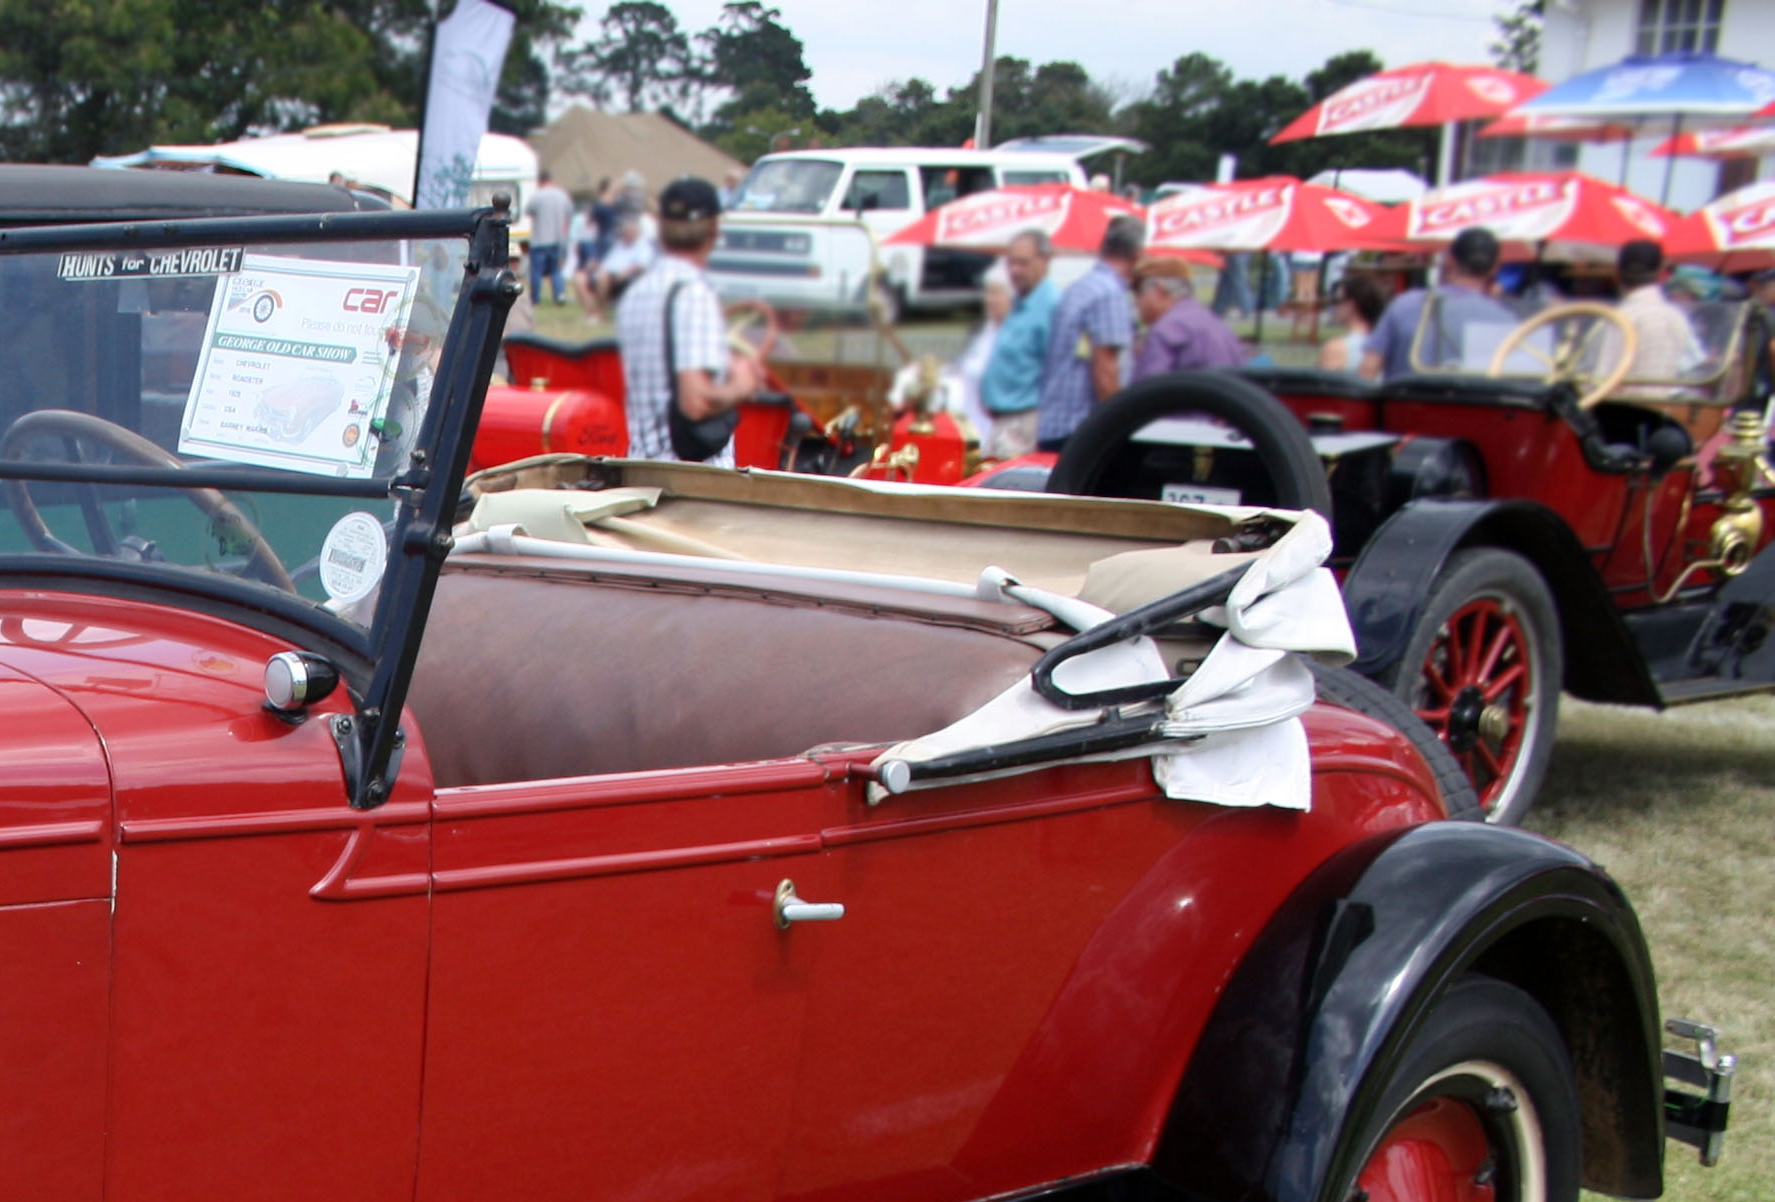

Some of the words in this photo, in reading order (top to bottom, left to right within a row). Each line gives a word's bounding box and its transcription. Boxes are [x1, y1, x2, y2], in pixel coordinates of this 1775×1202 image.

[951, 194, 1055, 231] CASTLE
[1162, 188, 1275, 231] CASTLE
[1428, 182, 1556, 226] CASTLE
[61, 254, 115, 277] HUNTS
[121, 256, 145, 271] for
[149, 248, 241, 274] CHEVROLET
[342, 288, 398, 314] car
[218, 335, 266, 351] GEORGE
[266, 341, 291, 353] OLD
[292, 344, 316, 356] CAR
[315, 346, 352, 361] SHOW
